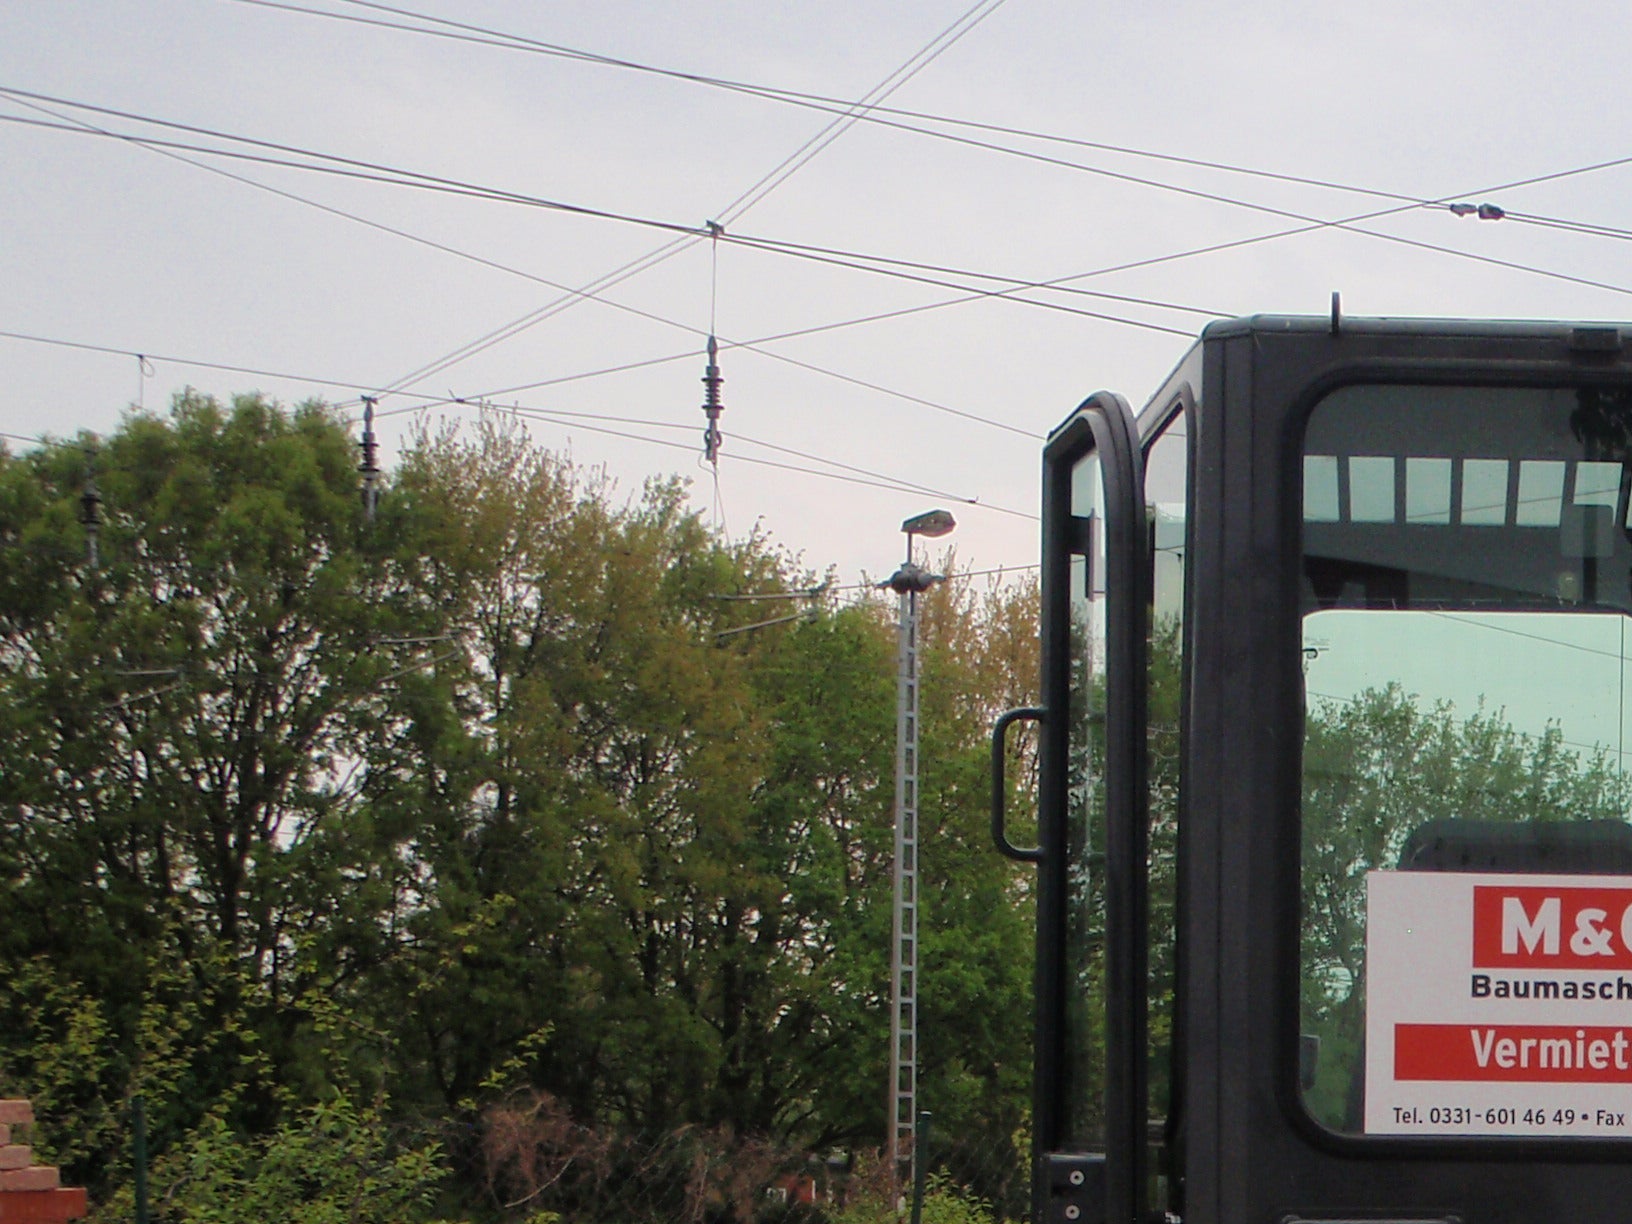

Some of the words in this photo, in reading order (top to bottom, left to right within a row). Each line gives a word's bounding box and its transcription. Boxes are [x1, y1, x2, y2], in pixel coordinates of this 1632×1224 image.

[1392, 1107, 1423, 1124] Tel.
[1522, 1108, 1546, 1125] 46
[1552, 1109, 1576, 1126] 49
[1596, 1109, 1625, 1127] Fax
